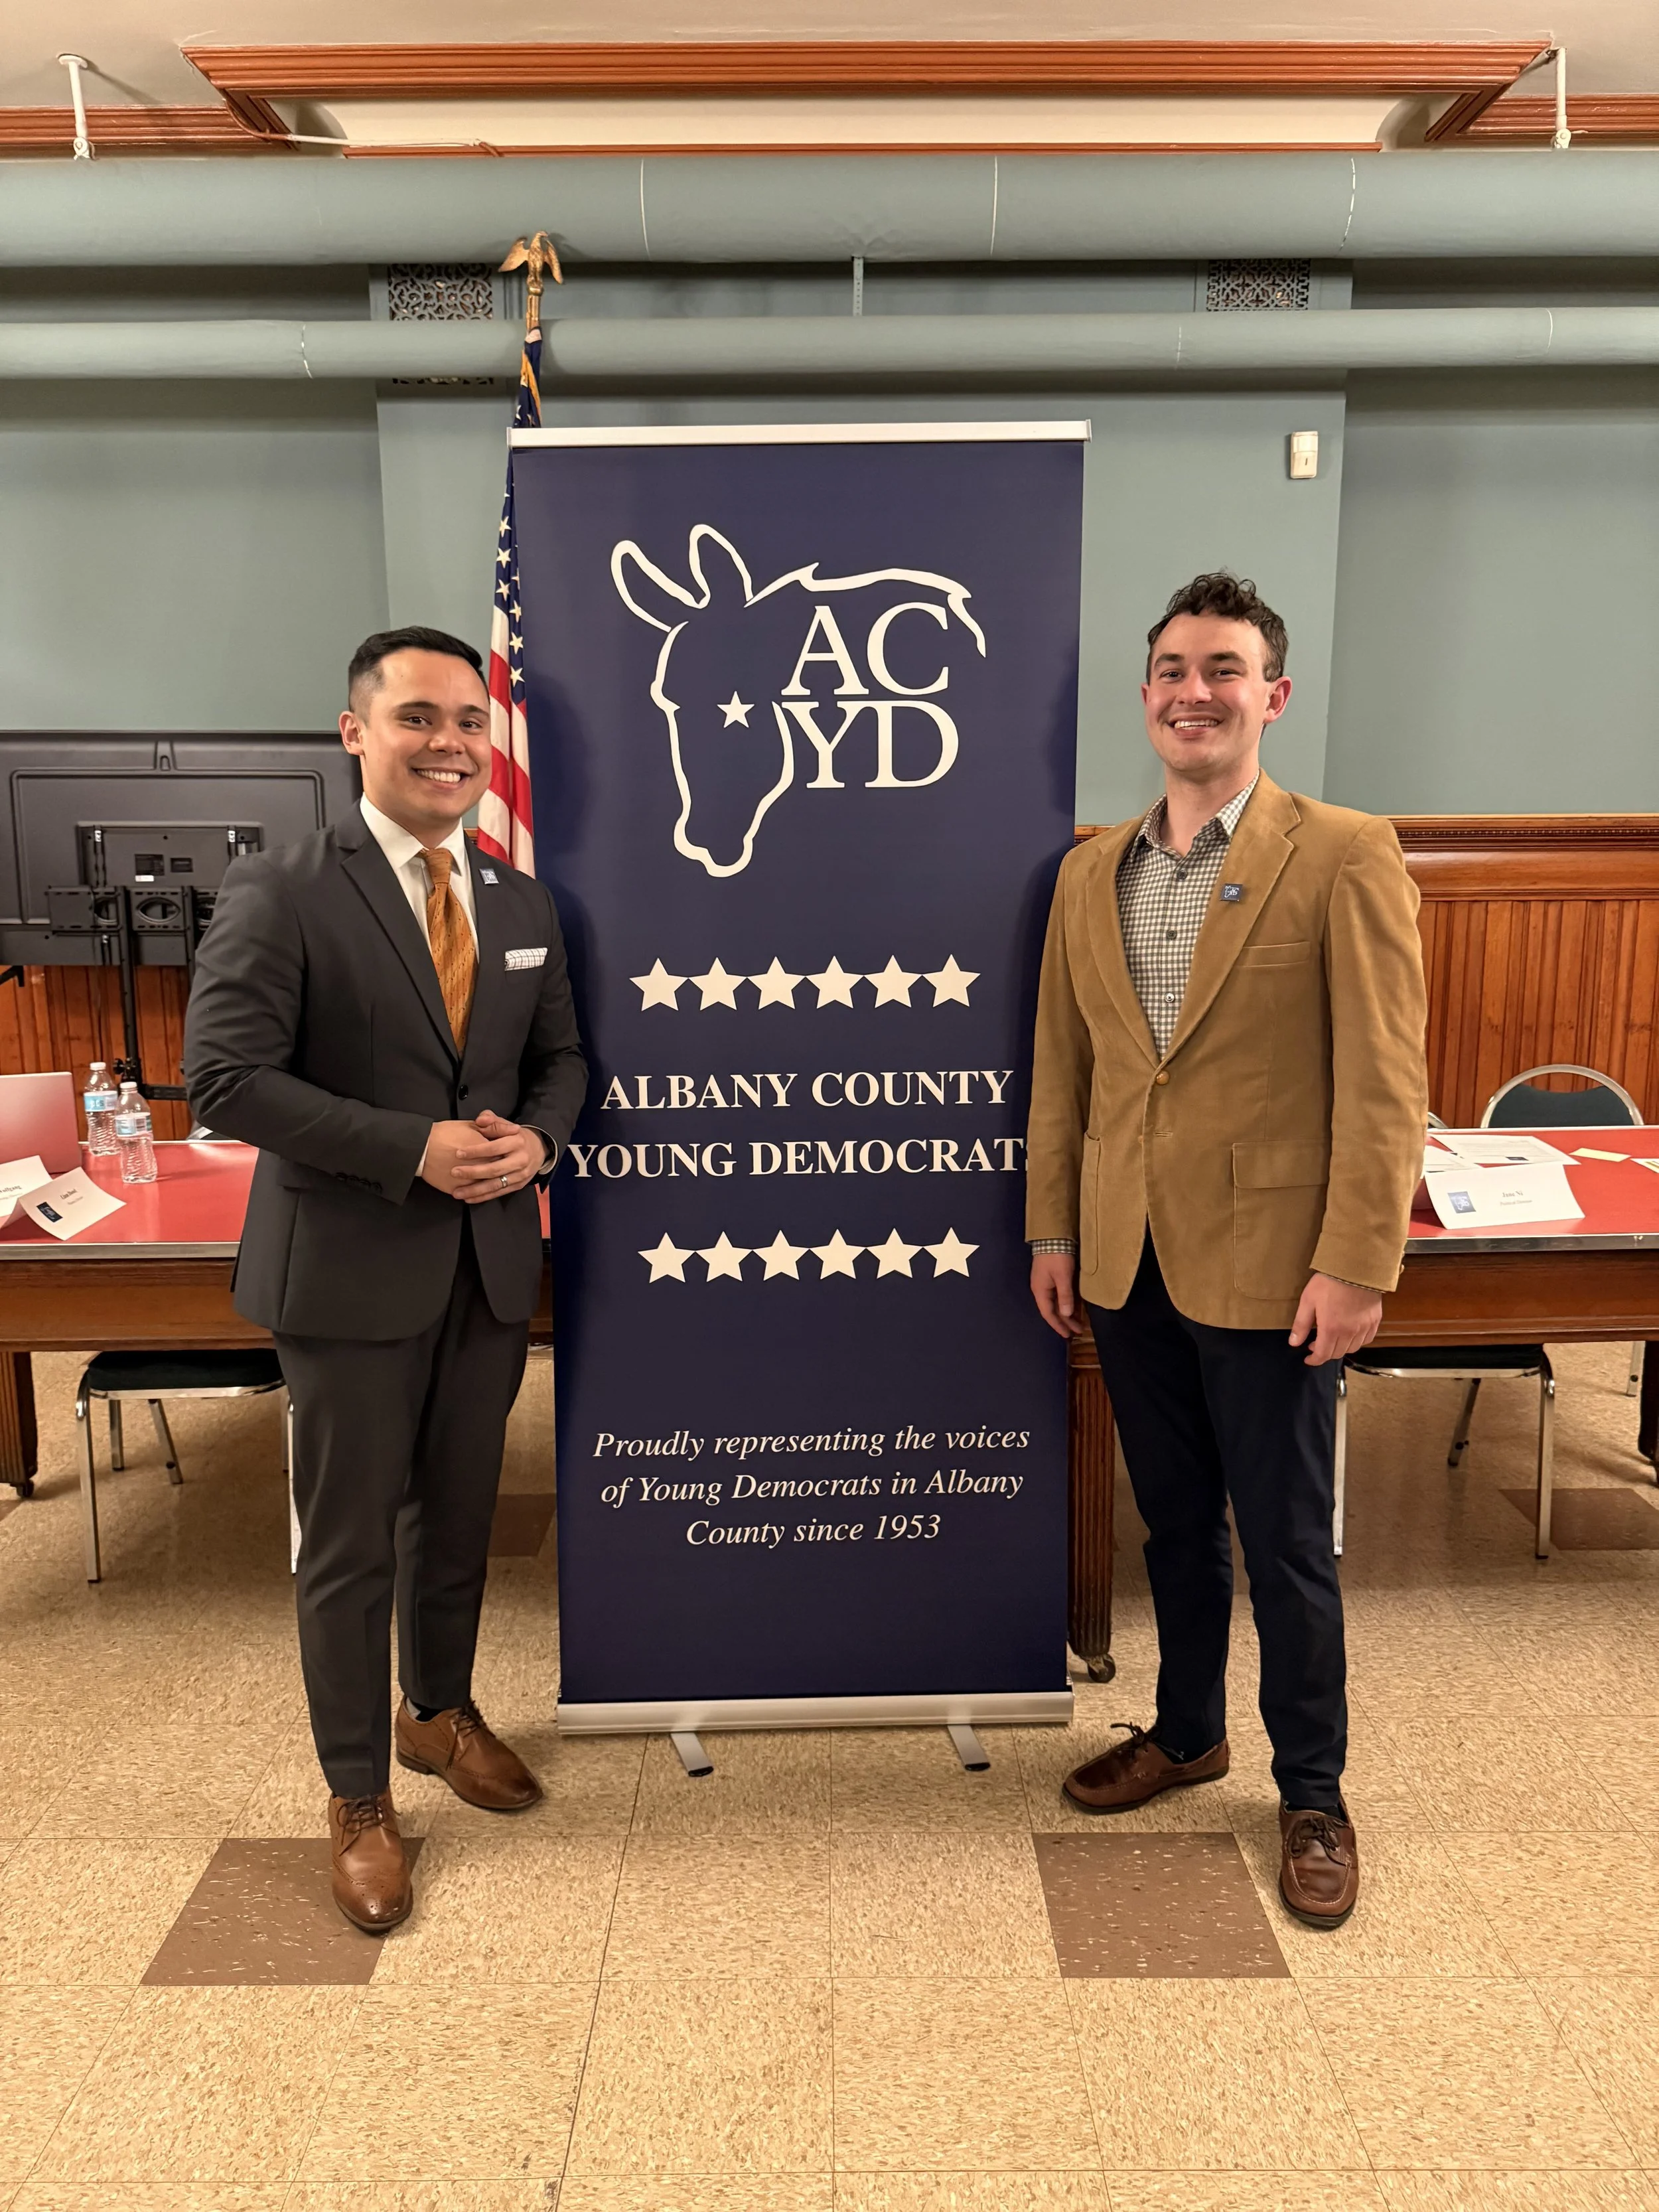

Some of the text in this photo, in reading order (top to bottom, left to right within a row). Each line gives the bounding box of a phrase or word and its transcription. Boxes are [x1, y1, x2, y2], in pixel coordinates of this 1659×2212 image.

[780, 601, 949, 696] AC
[781, 700, 959, 788] YD
[601, 1070, 1014, 1110] ALBANY COUNTY
[567, 1138, 1028, 1178] YOUNG DEMOCRAT
[592, 1425, 1030, 1461] Proudly representing the voices
[601, 1469, 1023, 1509] of Young Democrats in Albany
[686, 1514, 941, 1549] County since 1953
